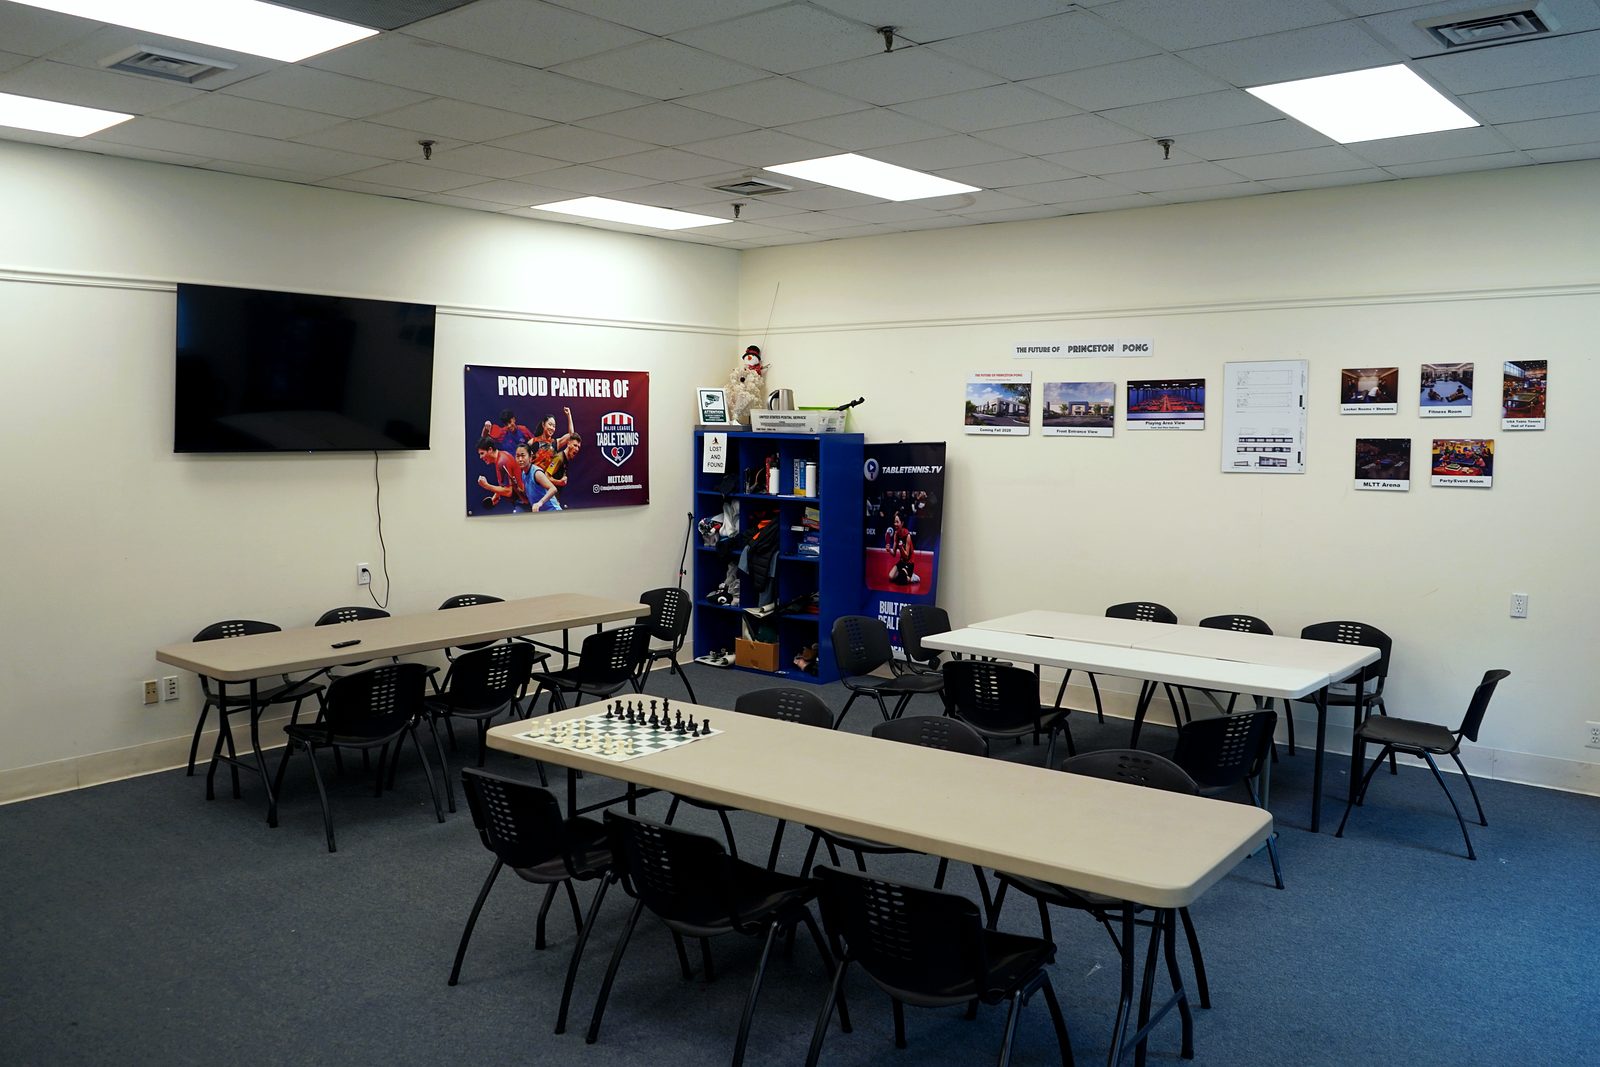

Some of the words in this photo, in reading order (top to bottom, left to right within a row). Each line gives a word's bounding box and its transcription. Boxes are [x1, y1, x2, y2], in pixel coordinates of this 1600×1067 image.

[1067, 344, 1114, 353] PRINCETON
[1122, 343, 1149, 352] PONG
[498, 376, 548, 397] PROUD
[550, 377, 611, 397] PARTNER
[612, 379, 629, 398] OF
[596, 432, 616, 446] TABLE
[616, 432, 639, 446] TENNIS
[882, 466, 942, 474] TABLETENNIS.TV
[608, 475, 633, 484] MLTT.COM
[880, 600, 898, 616] BUILT
